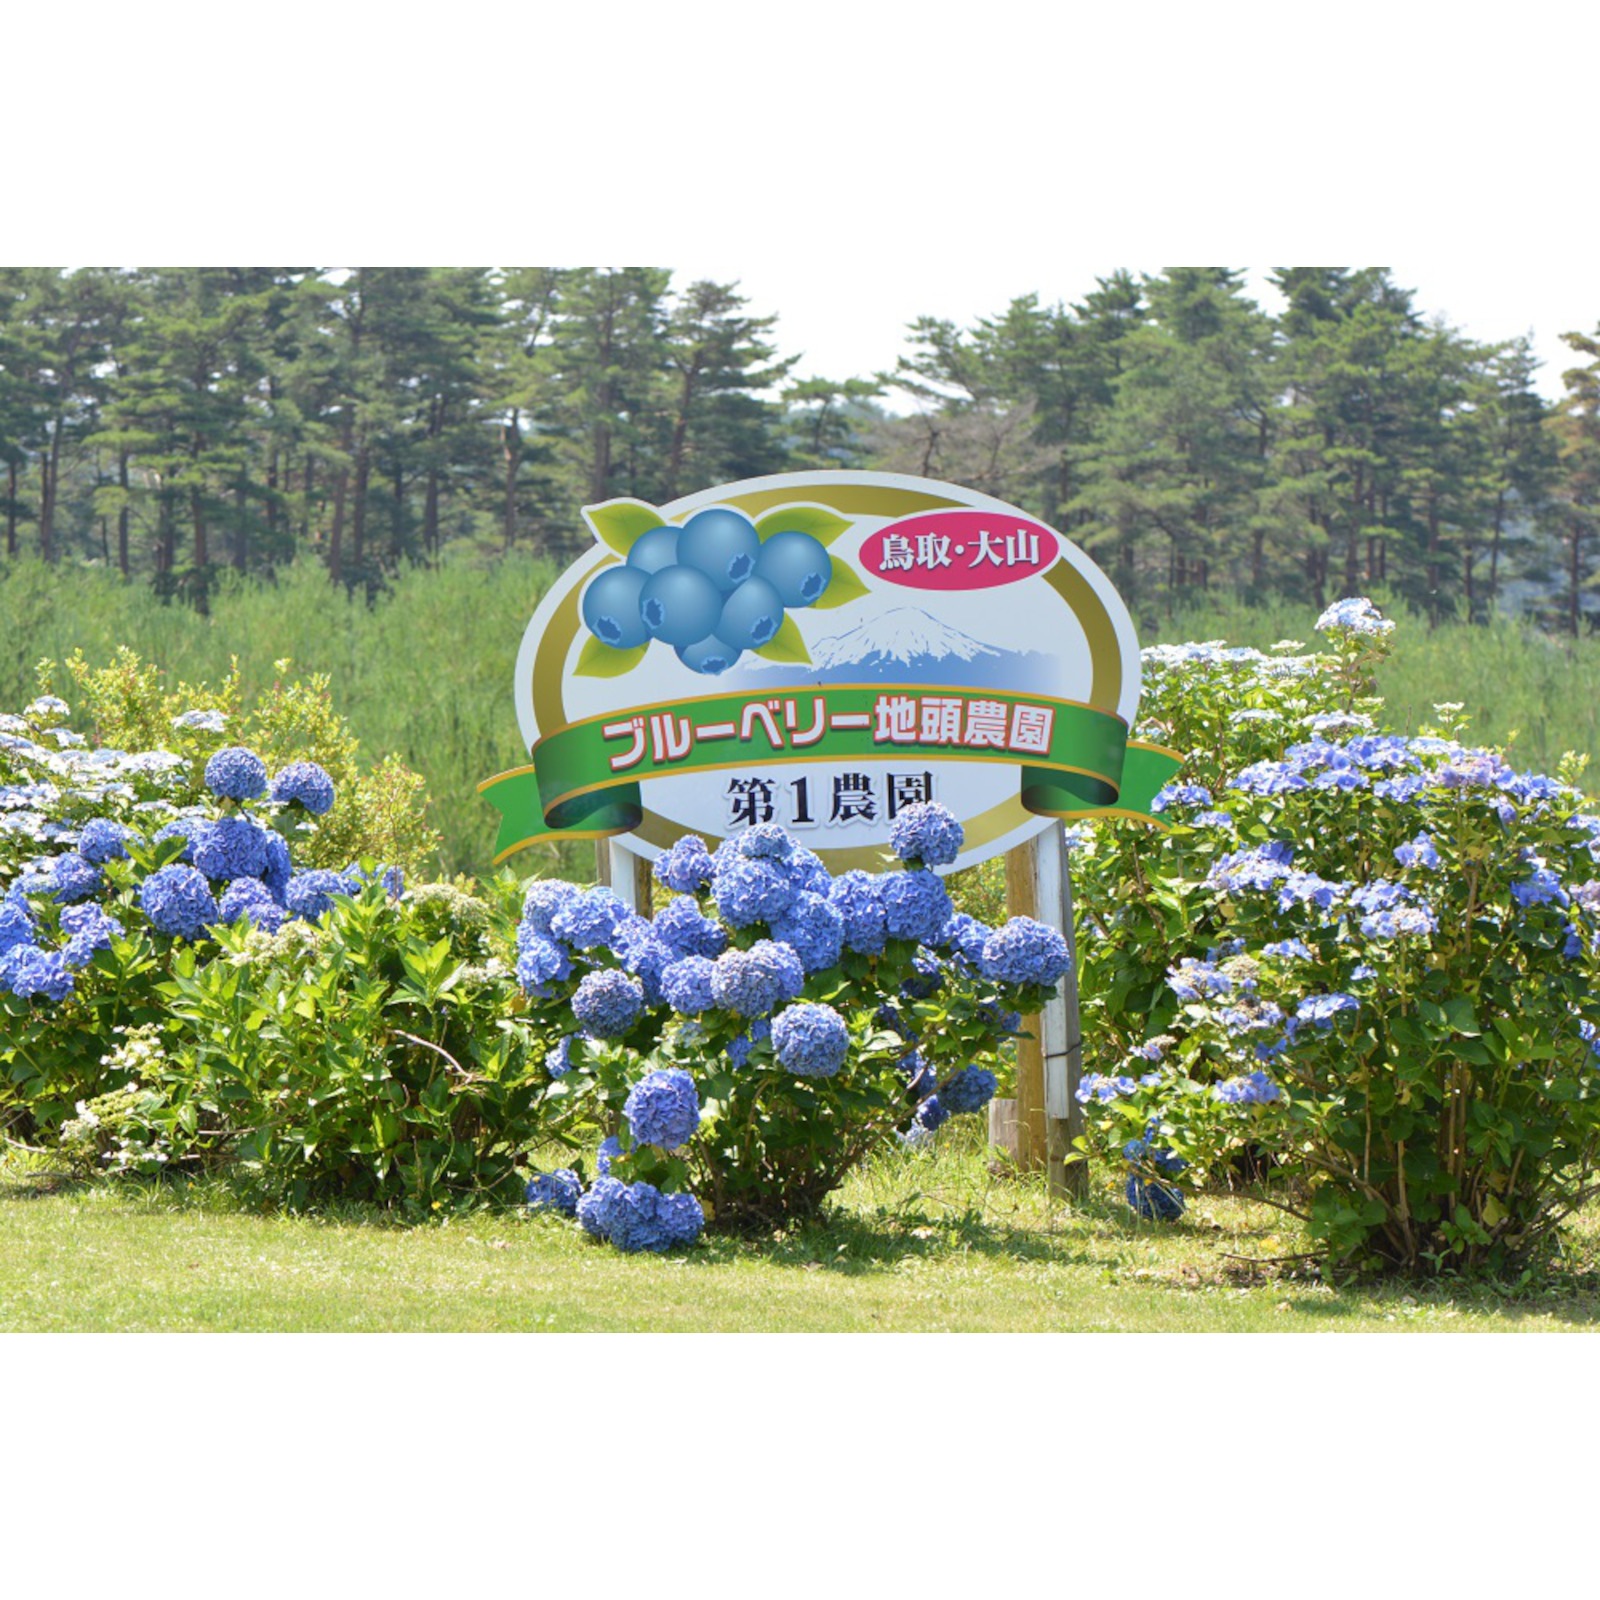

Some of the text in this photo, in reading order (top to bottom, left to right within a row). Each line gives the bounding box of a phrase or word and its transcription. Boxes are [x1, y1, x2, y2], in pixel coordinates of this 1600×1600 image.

[879, 529, 1039, 572] 鳥取・大山
[603, 695, 1055, 770] ブルーベリー地頭農園
